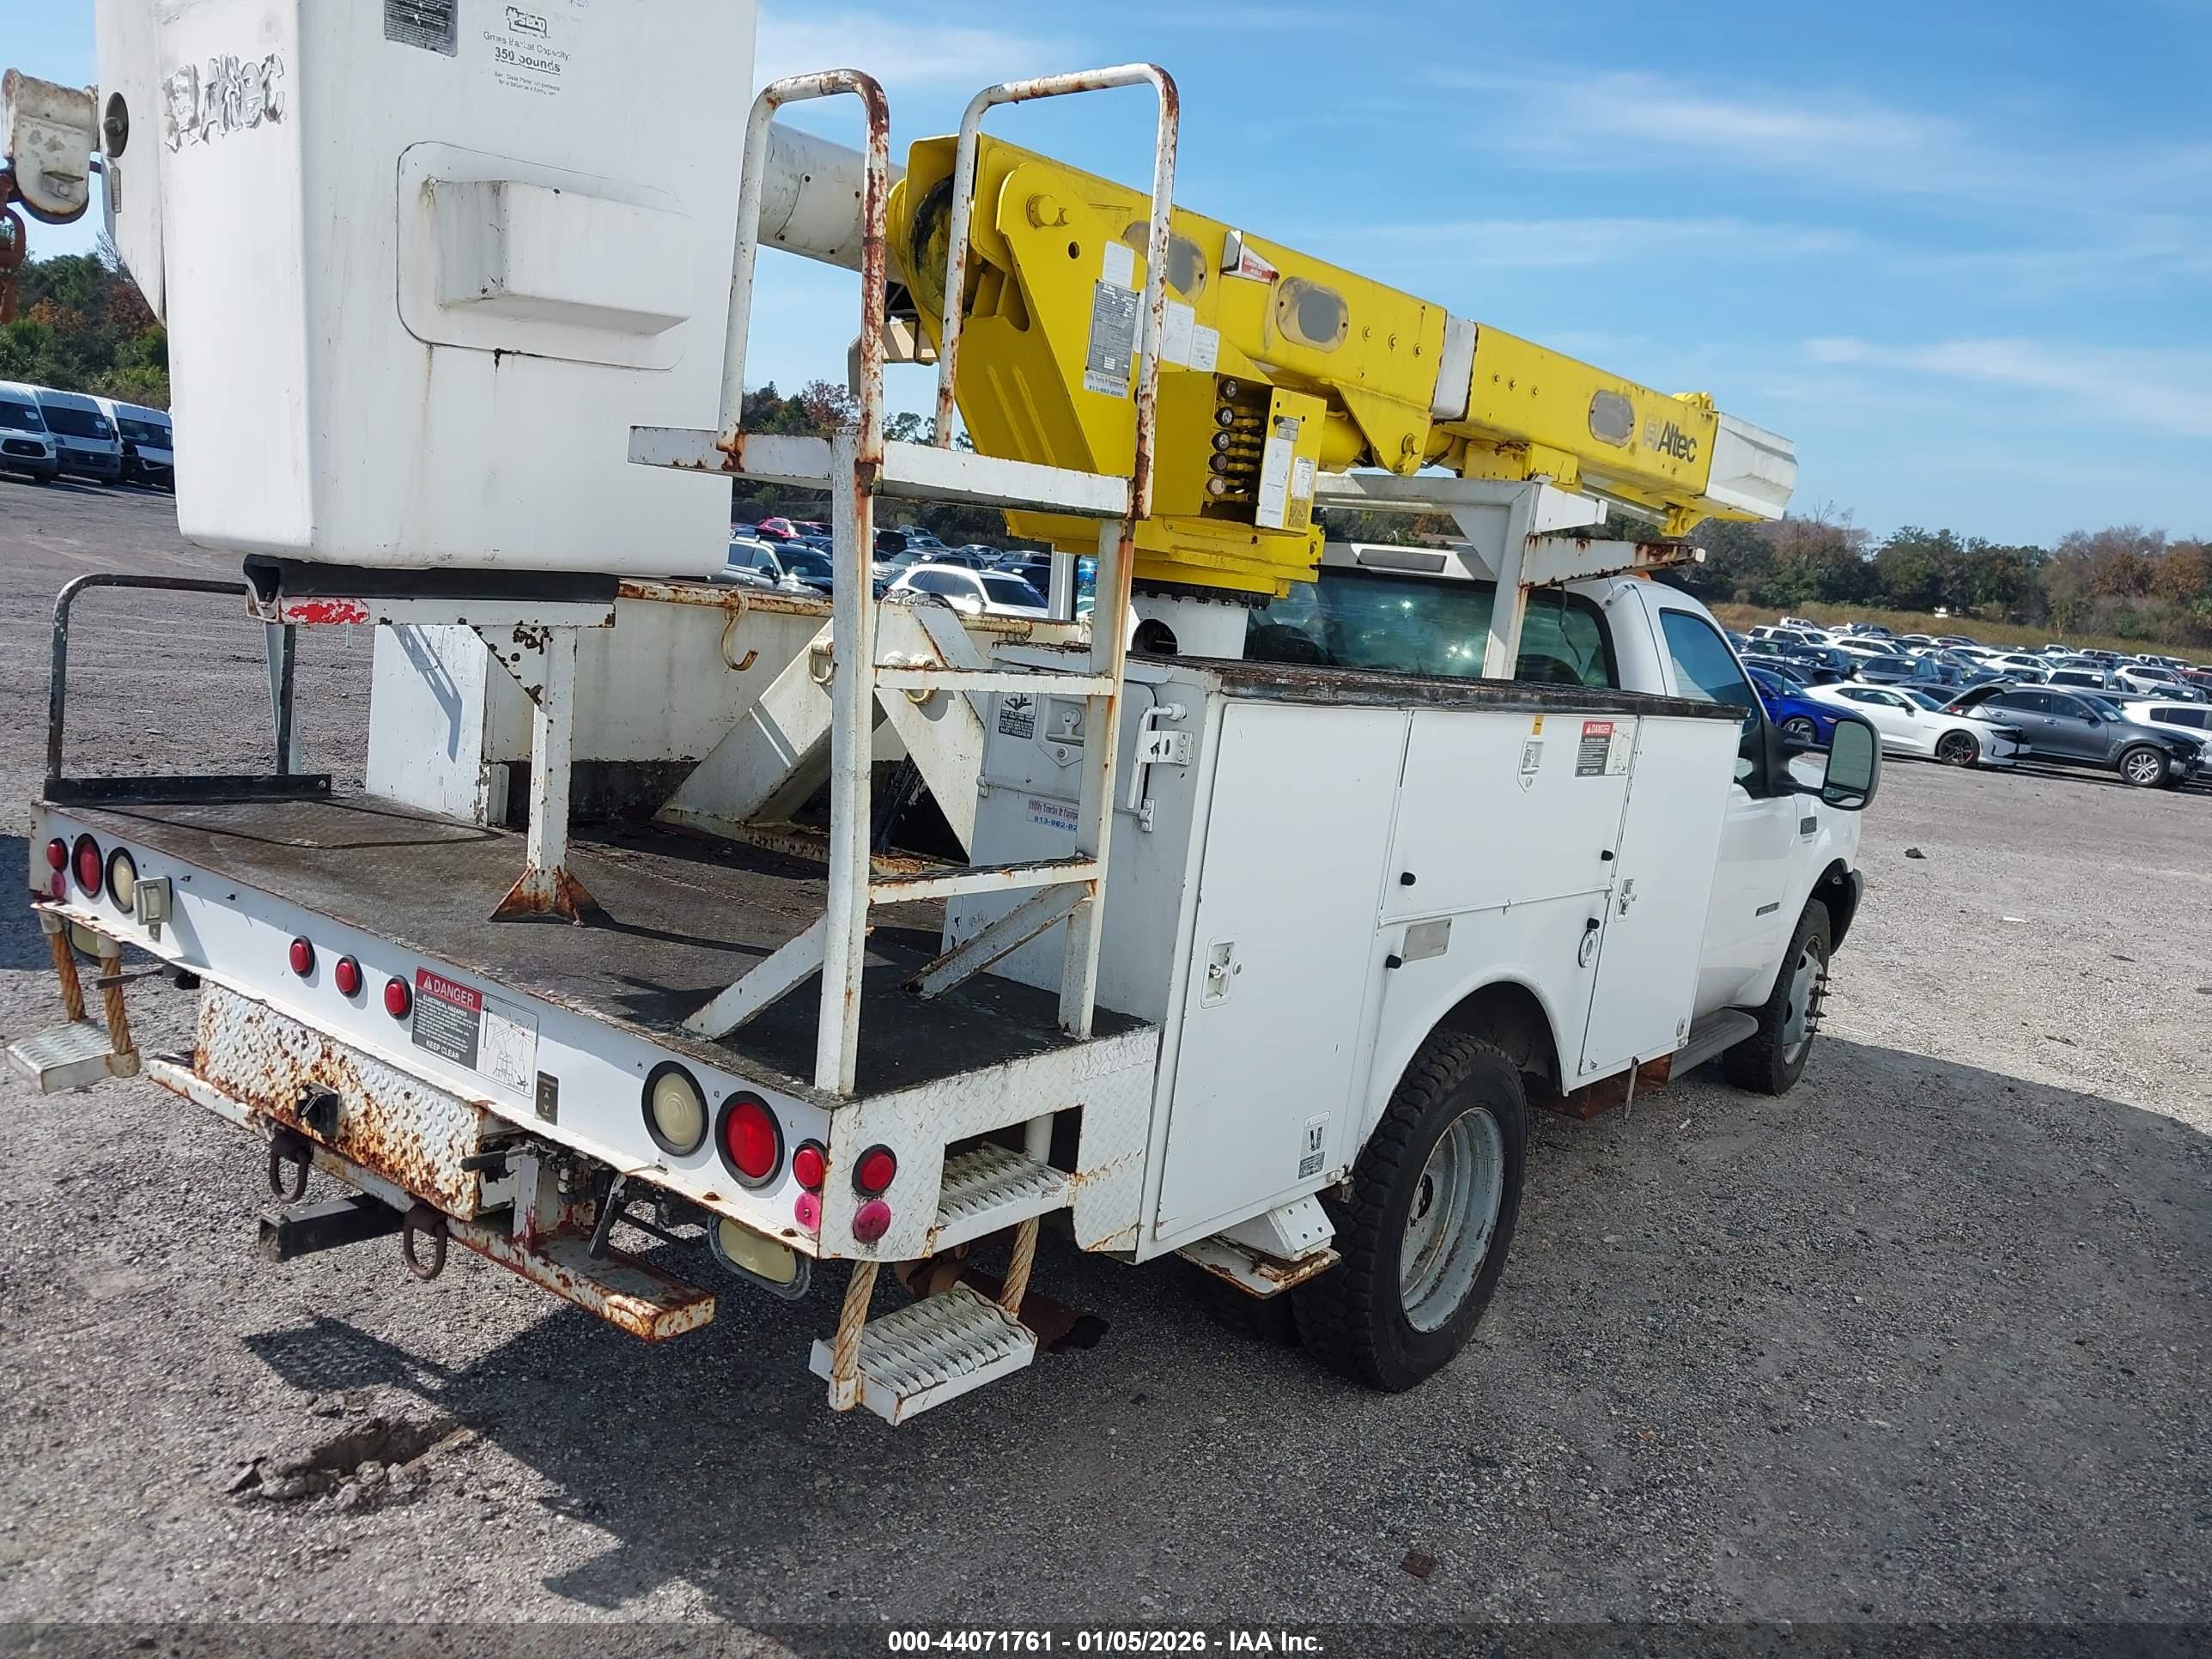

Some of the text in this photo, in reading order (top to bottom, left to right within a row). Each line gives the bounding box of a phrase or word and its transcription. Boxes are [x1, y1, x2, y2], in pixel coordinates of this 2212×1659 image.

[495, 46, 561, 72] 350 pounds
[1657, 421, 1698, 463] Altec
[422, 994, 468, 1018] ELECTRICAL HAZARDS
[433, 980, 474, 1007] DANGER
[425, 1039, 460, 1061] KEEP CLEAR
